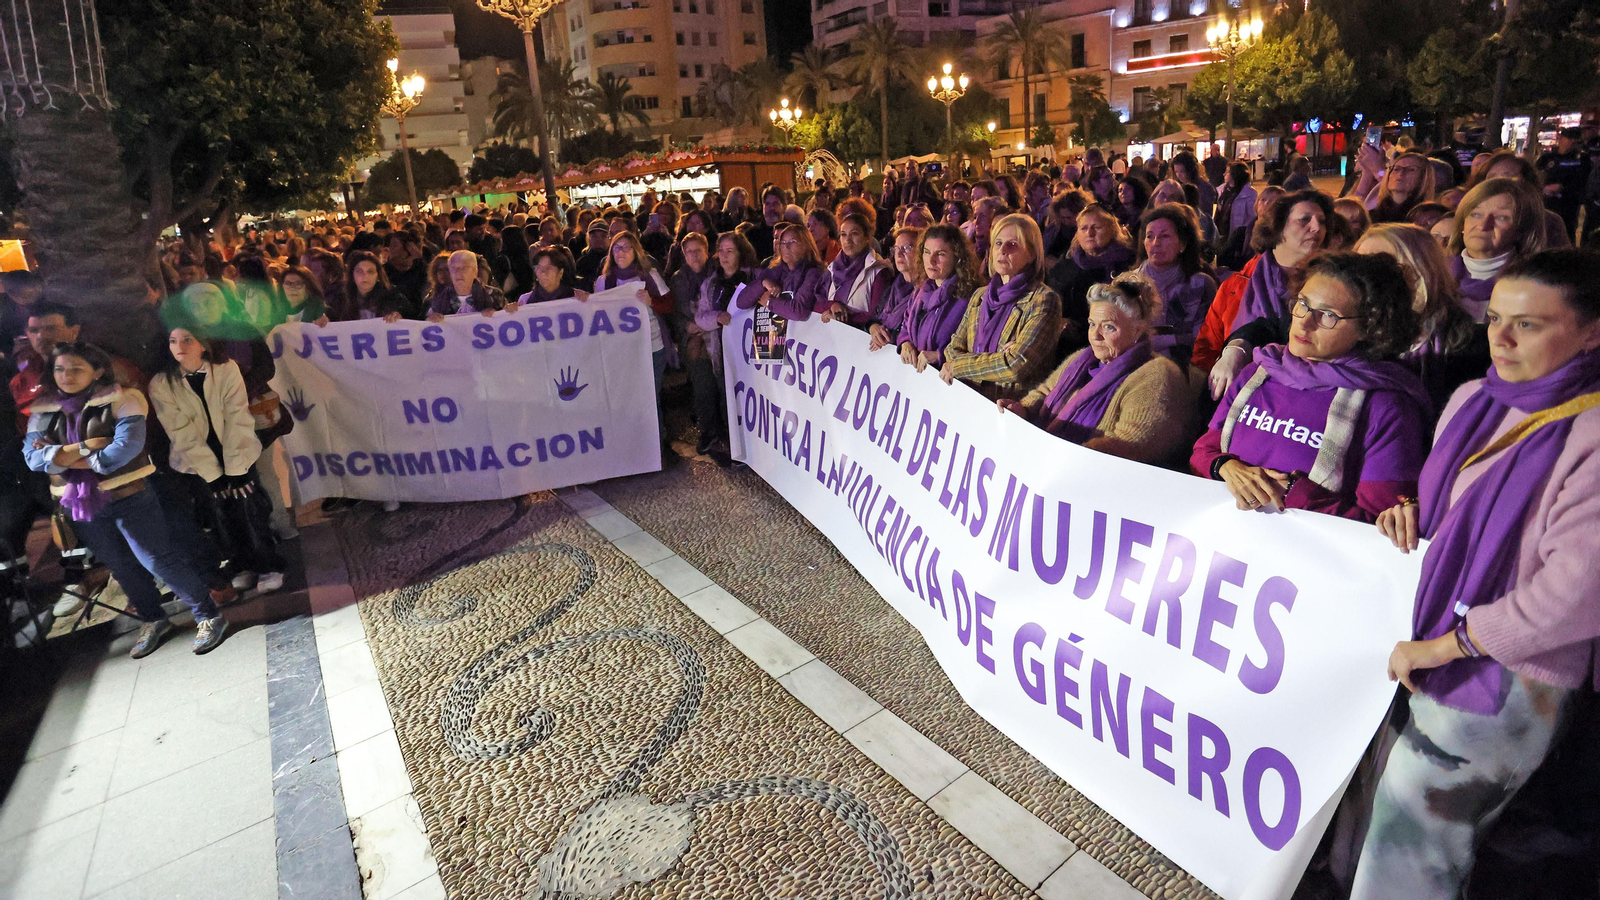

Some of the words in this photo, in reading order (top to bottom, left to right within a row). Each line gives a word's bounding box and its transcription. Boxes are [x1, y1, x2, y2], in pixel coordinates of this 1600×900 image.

[271, 325, 446, 361] UJERES
[471, 306, 643, 350] SORDAS
[402, 396, 458, 424] NO
[1237, 404, 1325, 449] #Hartas
[293, 427, 605, 482] DISCRIMINACION
[742, 318, 838, 406] CSEJO
[833, 366, 911, 463] LOCAL
[906, 409, 948, 492] DE
[938, 432, 996, 538] LAS
[987, 473, 1299, 695] MUJERES
[734, 381, 812, 472] CONTRA
[951, 569, 997, 676] DE
[1012, 621, 1302, 852] GÉNERO
